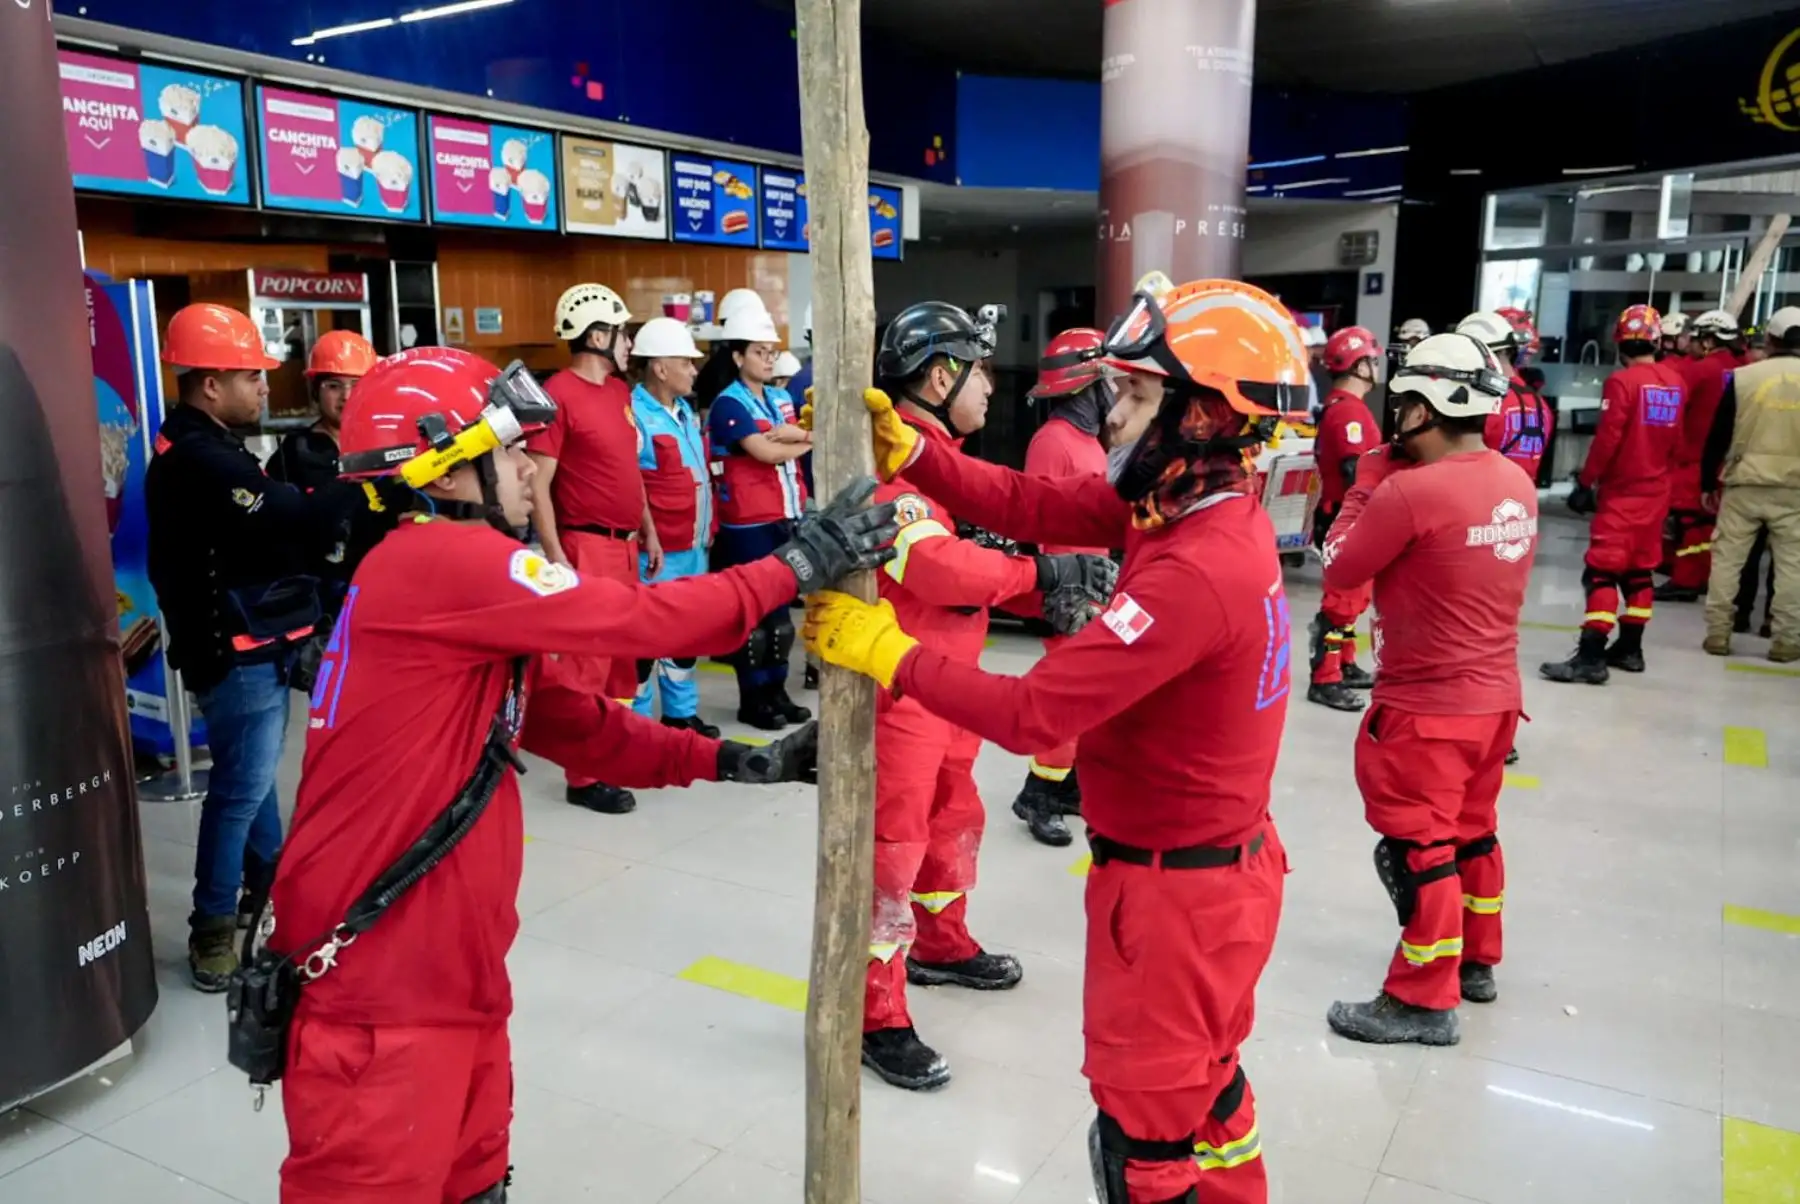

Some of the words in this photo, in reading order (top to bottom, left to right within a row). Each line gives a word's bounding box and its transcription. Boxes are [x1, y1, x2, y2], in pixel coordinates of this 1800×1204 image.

[63, 96, 139, 121] ANCHITA
[268, 128, 337, 149] CANCHITA
[260, 276, 358, 295] POPCORN
[0, 851, 80, 891] KOEPP
[78, 921, 127, 967] NEON
